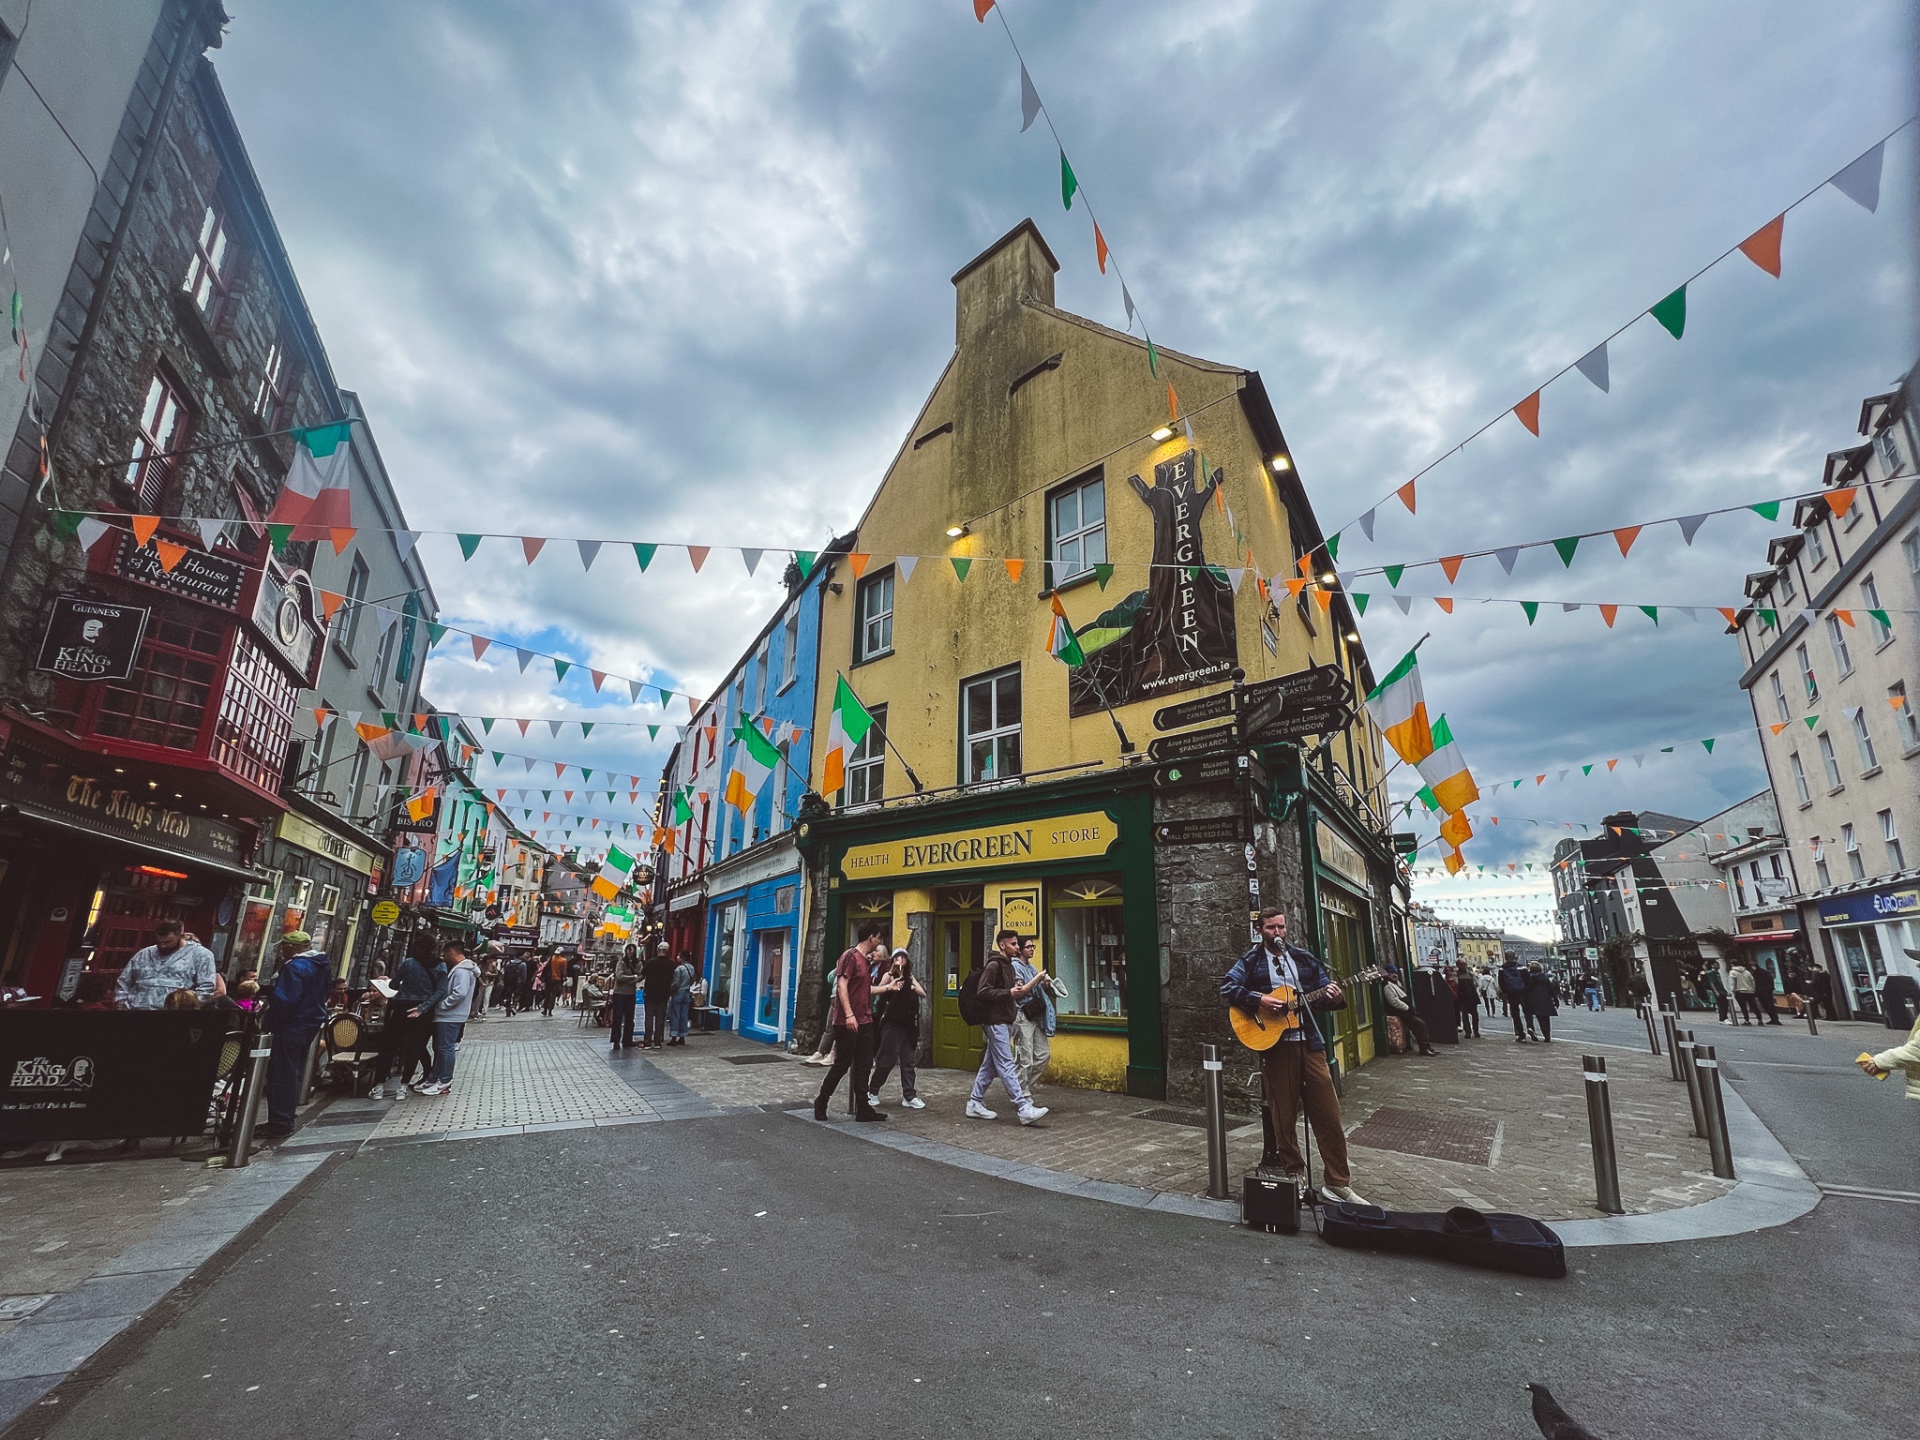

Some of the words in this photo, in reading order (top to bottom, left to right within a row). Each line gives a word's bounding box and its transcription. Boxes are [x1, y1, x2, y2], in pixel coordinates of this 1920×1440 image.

[184, 558, 229, 582] House
[145, 561, 229, 597] Restaurant
[72, 603, 121, 618] GUINNESS
[53, 660, 105, 674] HEAD
[1142, 660, 1230, 691] www.evergreen.ie
[1302, 694, 1332, 704] CHURCH
[1186, 711, 1207, 720] CANAL
[1302, 713, 1330, 723] Linsigh
[1290, 721, 1325, 733] WINDOW
[1178, 742, 1208, 753] SPANISH
[1208, 738, 1228, 748] ARCH
[1200, 768, 1230, 778] MUSEUM
[66, 775, 101, 808] The
[105, 790, 153, 831] Kings
[156, 808, 190, 838] Head
[396, 817, 434, 828] BISRO
[1217, 830, 1233, 838] EARL
[851, 853, 890, 868] HEALTH
[902, 829, 1033, 868] EVERGREEN
[1051, 827, 1100, 844] STORE
[1005, 904, 1034, 918] EVERGREEN
[1005, 920, 1033, 928] CORNER
[10, 1075, 60, 1087] HEAD
